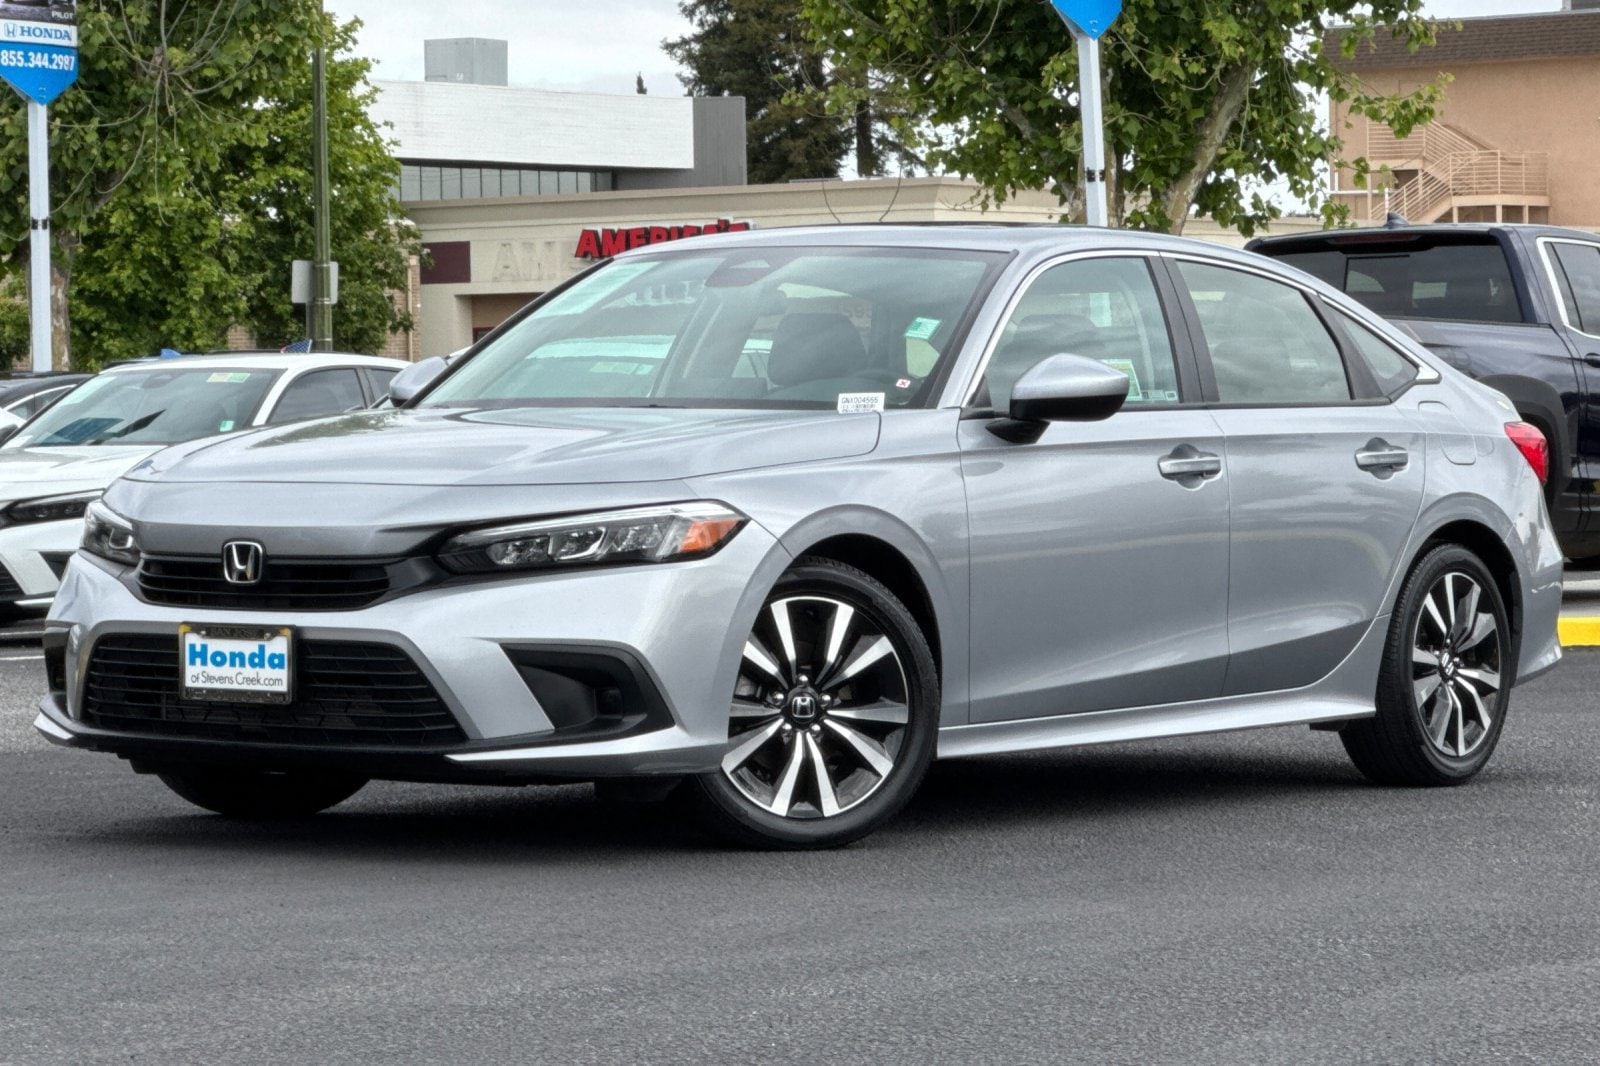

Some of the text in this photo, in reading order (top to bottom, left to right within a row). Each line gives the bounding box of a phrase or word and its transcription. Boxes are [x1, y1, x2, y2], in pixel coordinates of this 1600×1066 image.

[51, 10, 74, 19] PILOT
[20, 25, 72, 41] HONDA
[0, 49, 75, 71] 855.344.2987
[188, 643, 286, 670] Honda
[191, 670, 283, 687] of Stevens Creek.com
